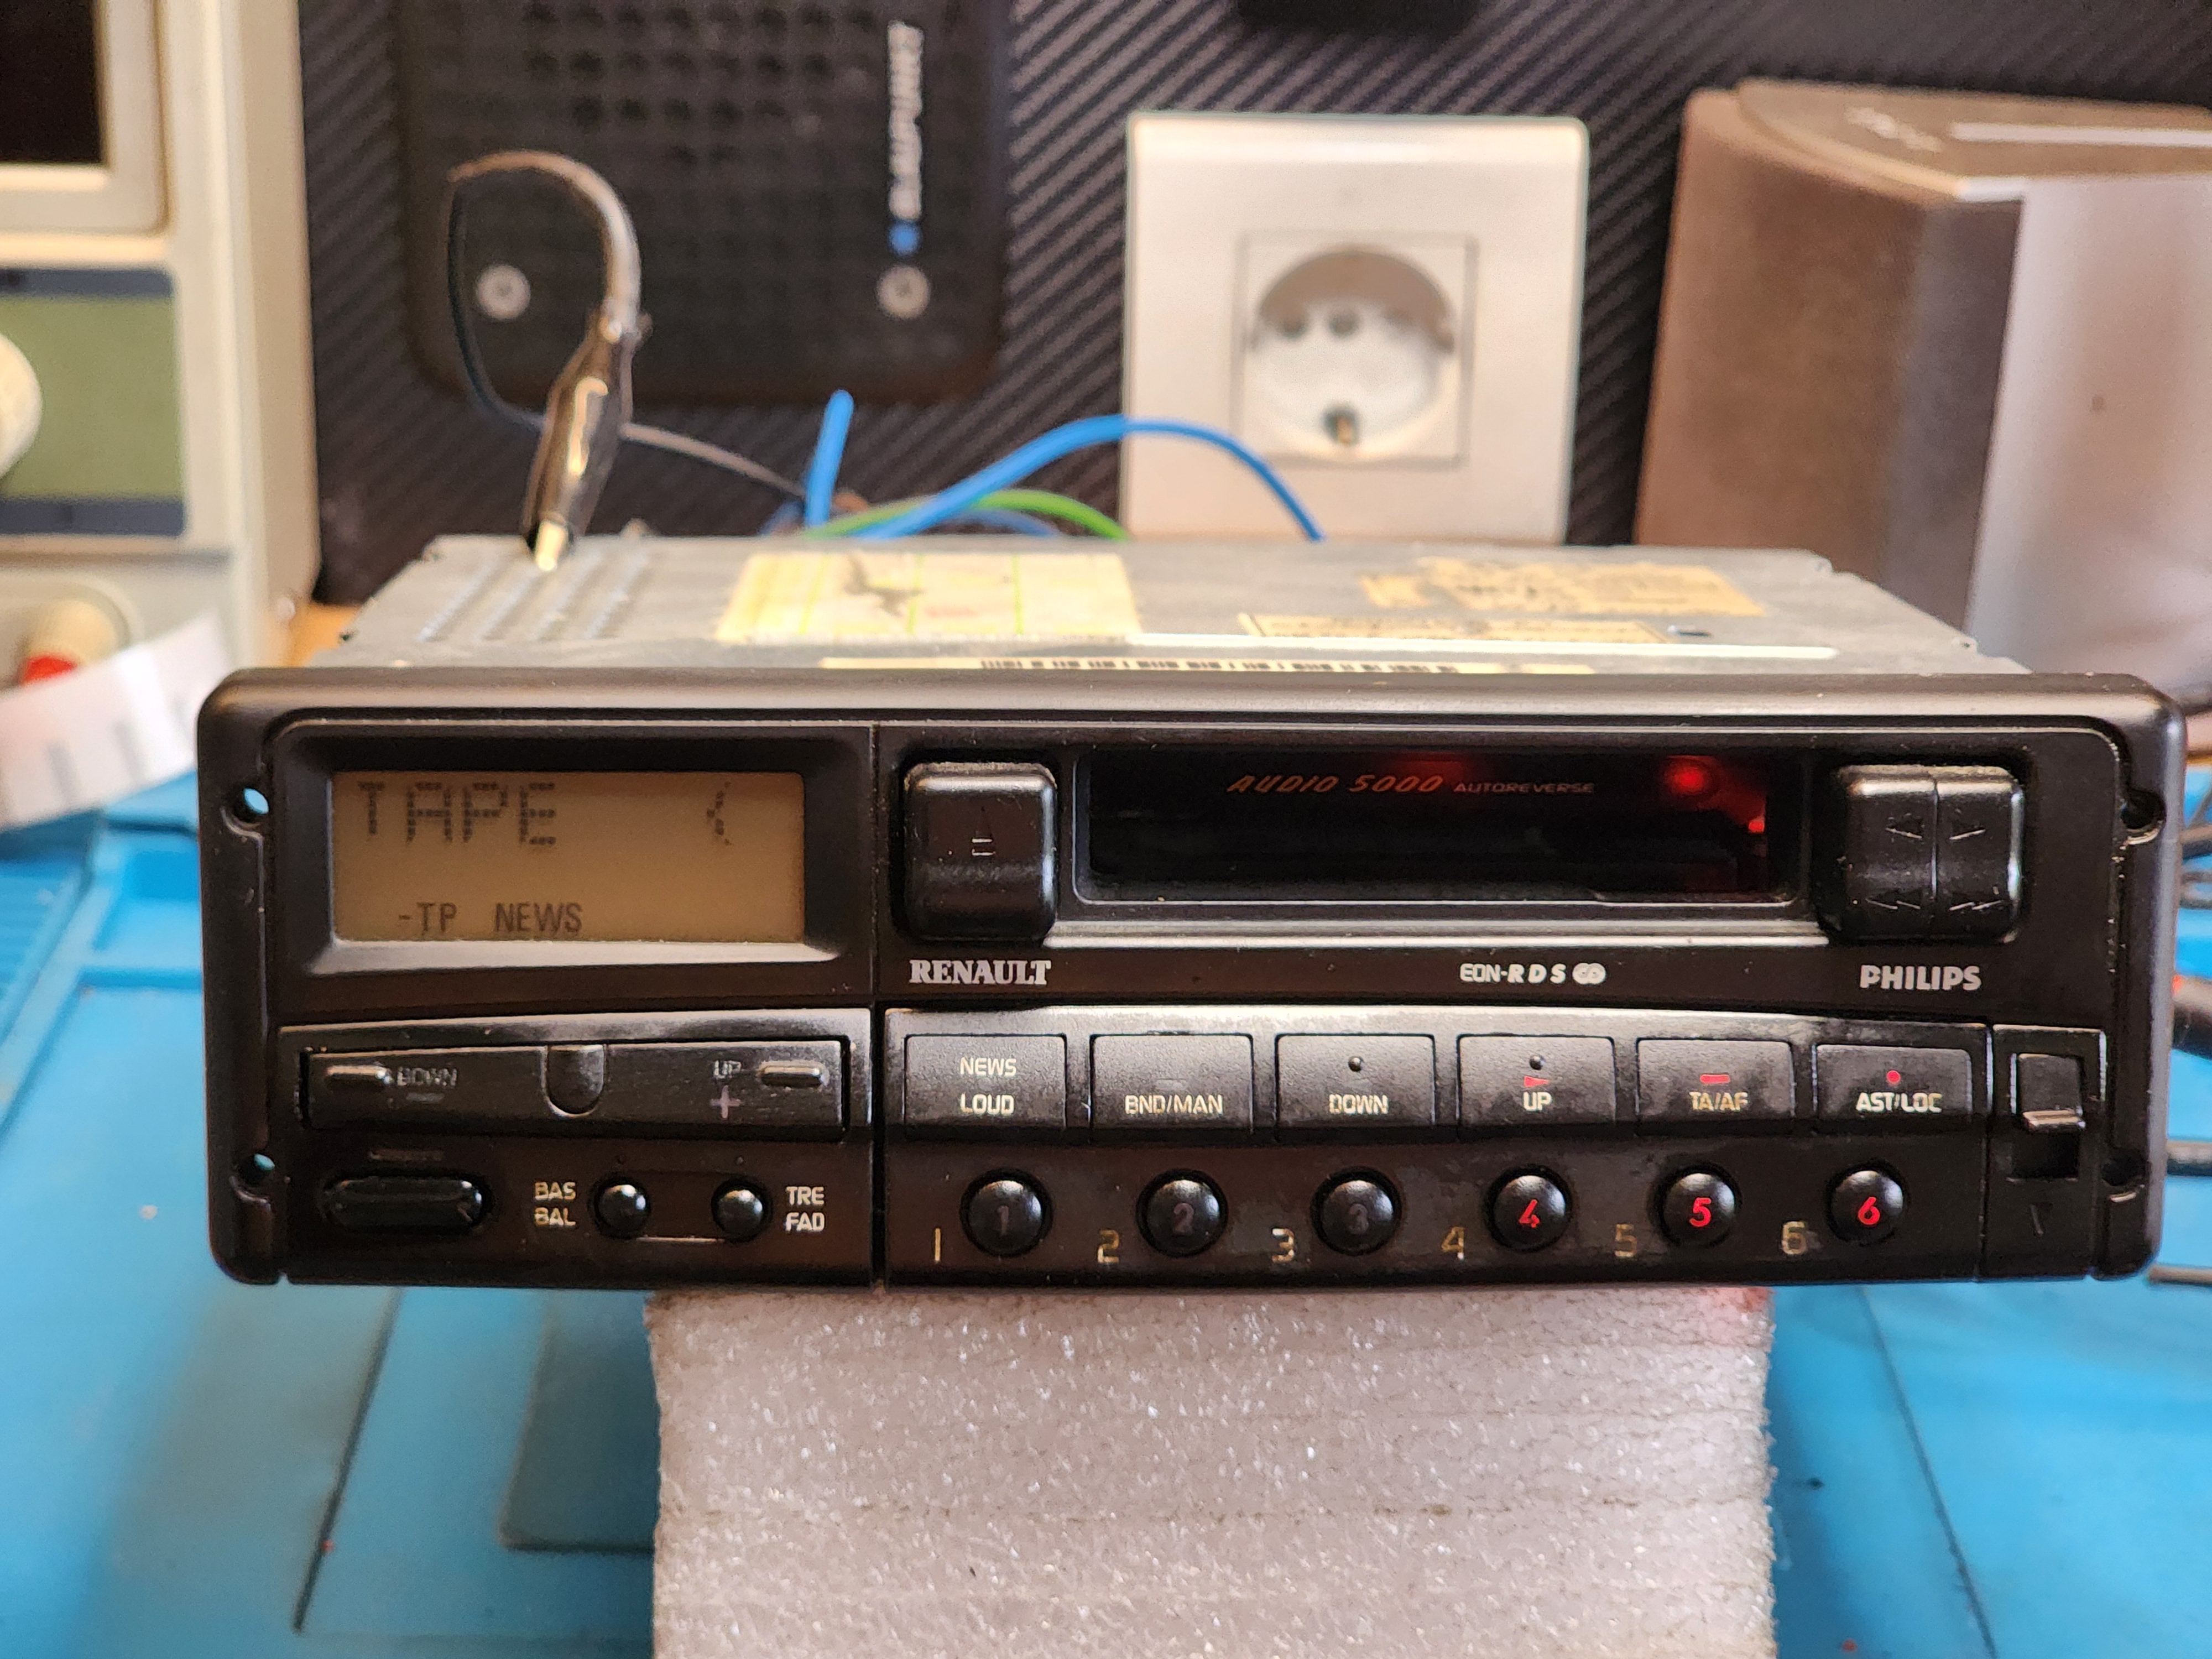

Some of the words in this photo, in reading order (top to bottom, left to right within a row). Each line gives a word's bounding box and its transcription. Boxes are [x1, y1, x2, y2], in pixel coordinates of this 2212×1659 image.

[1348, 775, 1444, 793] 5000
[1453, 782, 1594, 794] AUTOREVERSE
[358, 781, 556, 846] TAPE
[495, 902, 582, 933] NEWS
[909, 959, 1051, 985] RENAULT
[1860, 964, 1982, 991] PHILIPS
[713, 1060, 742, 1079] UP
[959, 1057, 1017, 1077] NEWS
[960, 1093, 1015, 1115] LOUD
[1124, 1094, 1223, 1114] BND/MAN
[1328, 1094, 1388, 1115] DOWN
[1522, 1091, 1552, 1112] UP
[1689, 1091, 1749, 1112] TA/AF
[1855, 1092, 1942, 1113] AST/LOC
[534, 1182, 576, 1201] BAS
[786, 1186, 825, 1205] TRE
[534, 1207, 576, 1227] BAL
[786, 1212, 825, 1232] FAD
[997, 1204, 1010, 1237] 1
[1172, 1202, 1194, 1236] 2
[1519, 1199, 1540, 1229] 4
[1689, 1197, 1712, 1228] 5
[1858, 1196, 1880, 1225] 6
[934, 1227, 941, 1263] 1
[1097, 1229, 1120, 1264] 2
[1271, 1228, 1295, 1262] 3
[1441, 1226, 1465, 1260] 4
[1614, 1223, 1637, 1258] 5
[1781, 1220, 1806, 1255] 6
